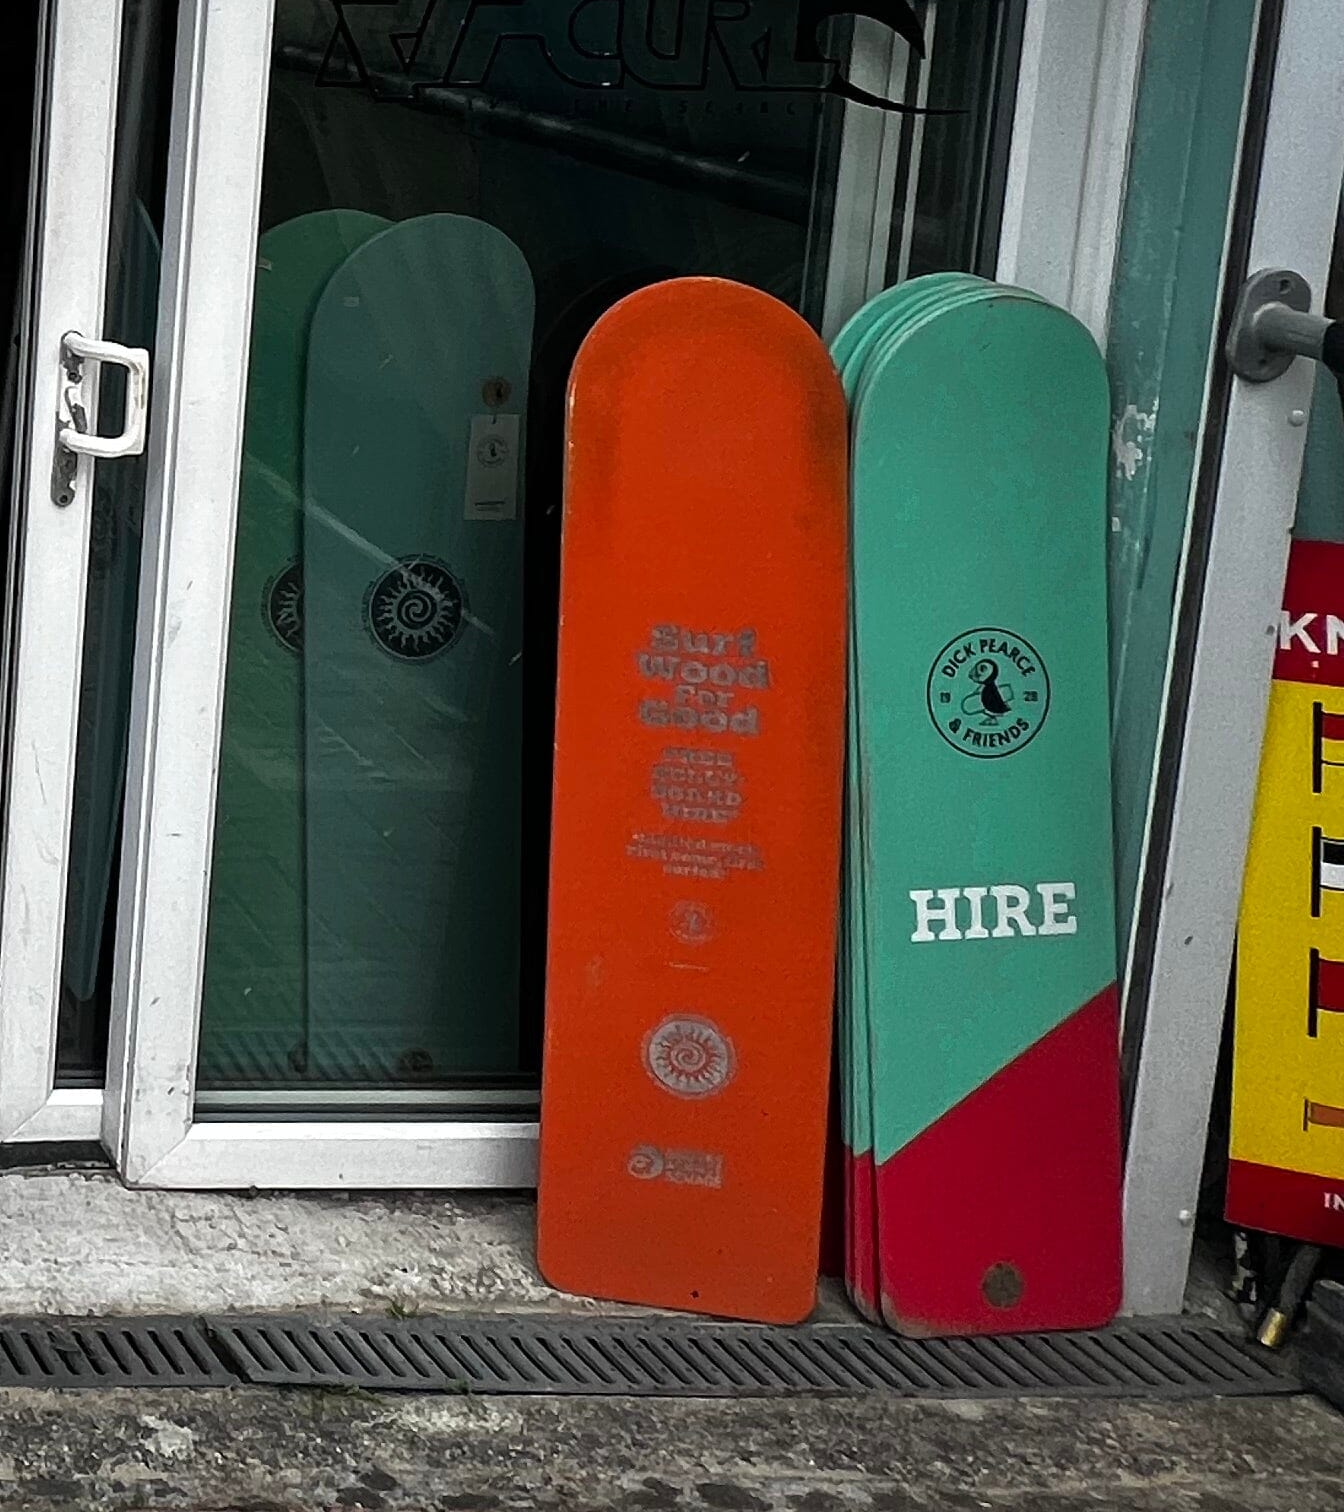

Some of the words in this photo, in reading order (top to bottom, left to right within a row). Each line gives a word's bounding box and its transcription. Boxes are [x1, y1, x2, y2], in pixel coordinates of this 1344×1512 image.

[941, 642, 977, 678] DICK
[978, 639, 1036, 677] PEARCE
[962, 717, 1030, 747] FRIENDS
[909, 882, 1077, 942] HIRE
